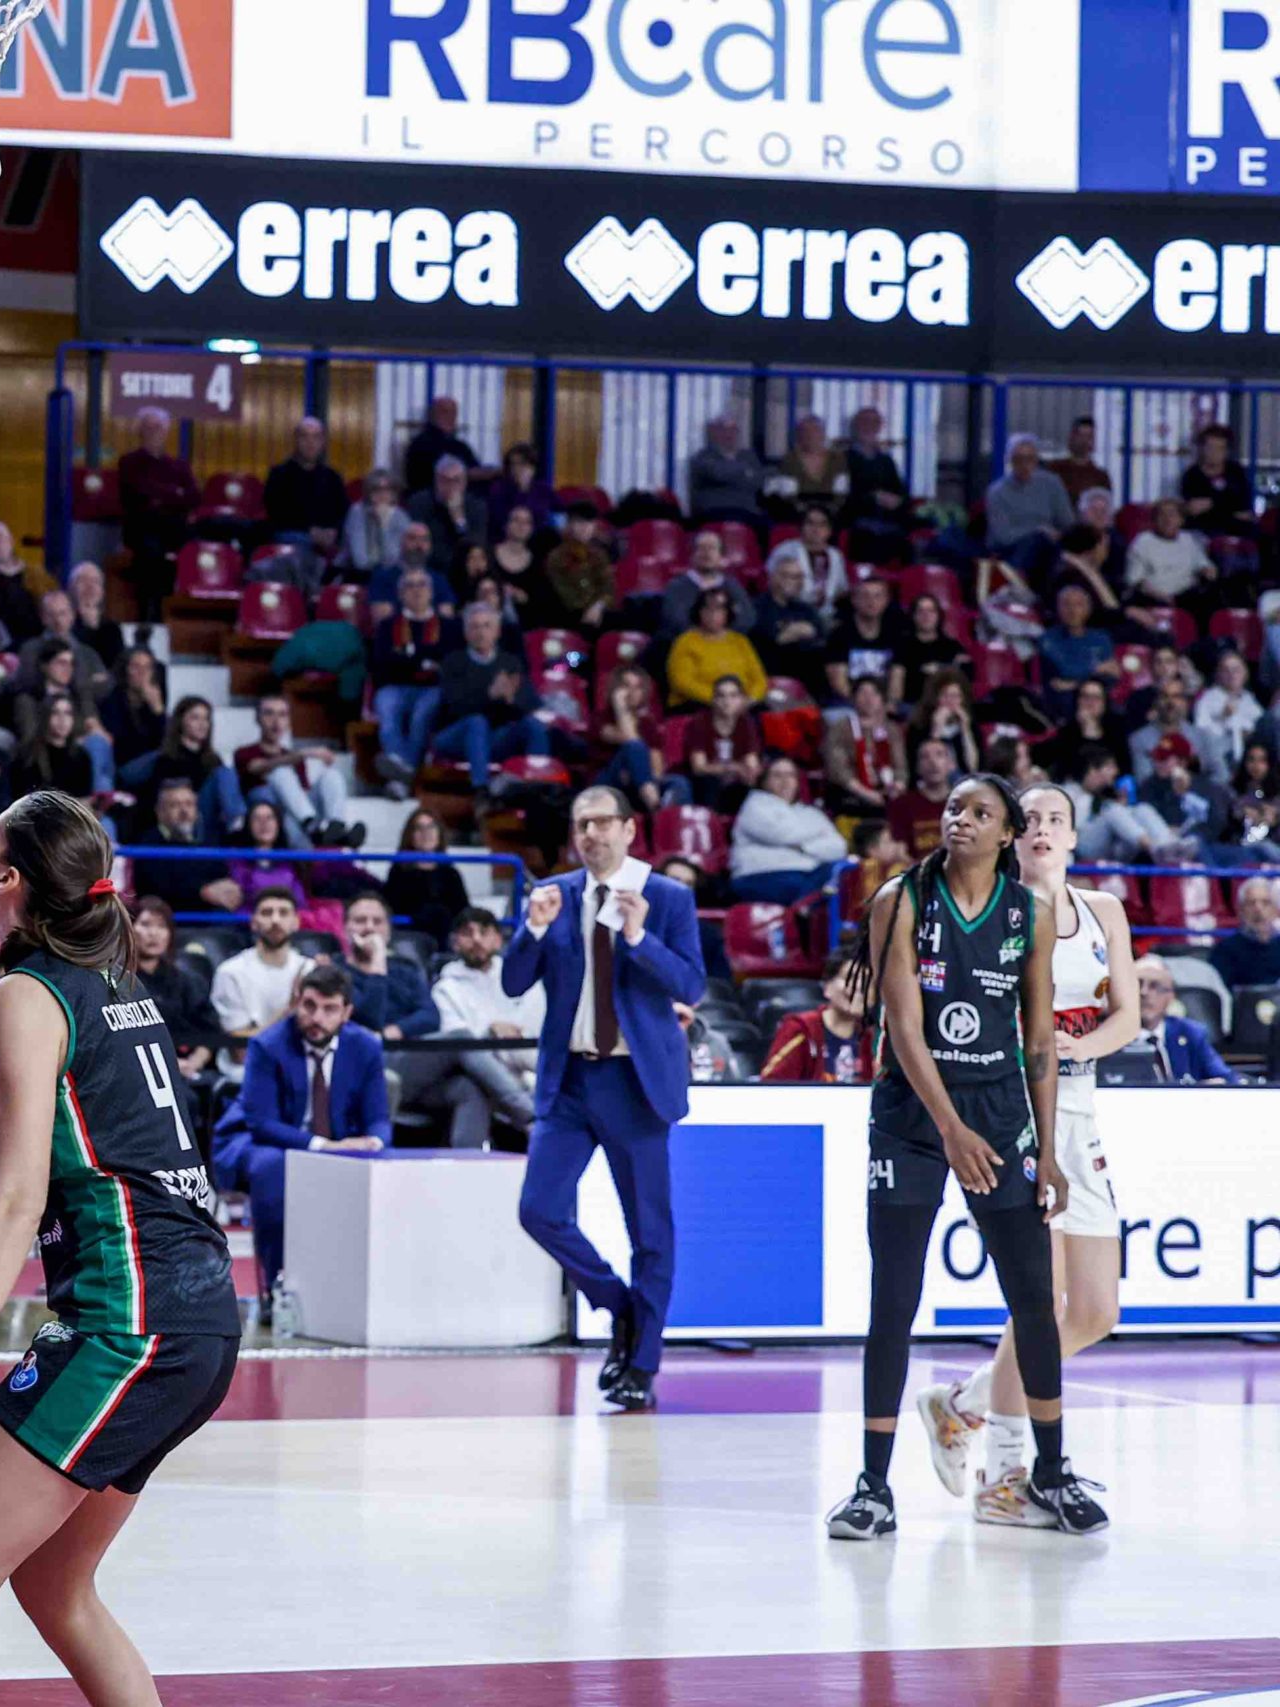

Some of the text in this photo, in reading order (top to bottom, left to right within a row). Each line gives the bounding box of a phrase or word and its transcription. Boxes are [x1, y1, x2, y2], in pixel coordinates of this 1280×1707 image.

[361, 114, 965, 177] IL PERCORSO
[236, 200, 519, 307] errea
[696, 220, 970, 327] errea
[205, 362, 232, 413] 4
[134, 1042, 193, 1151] 4
